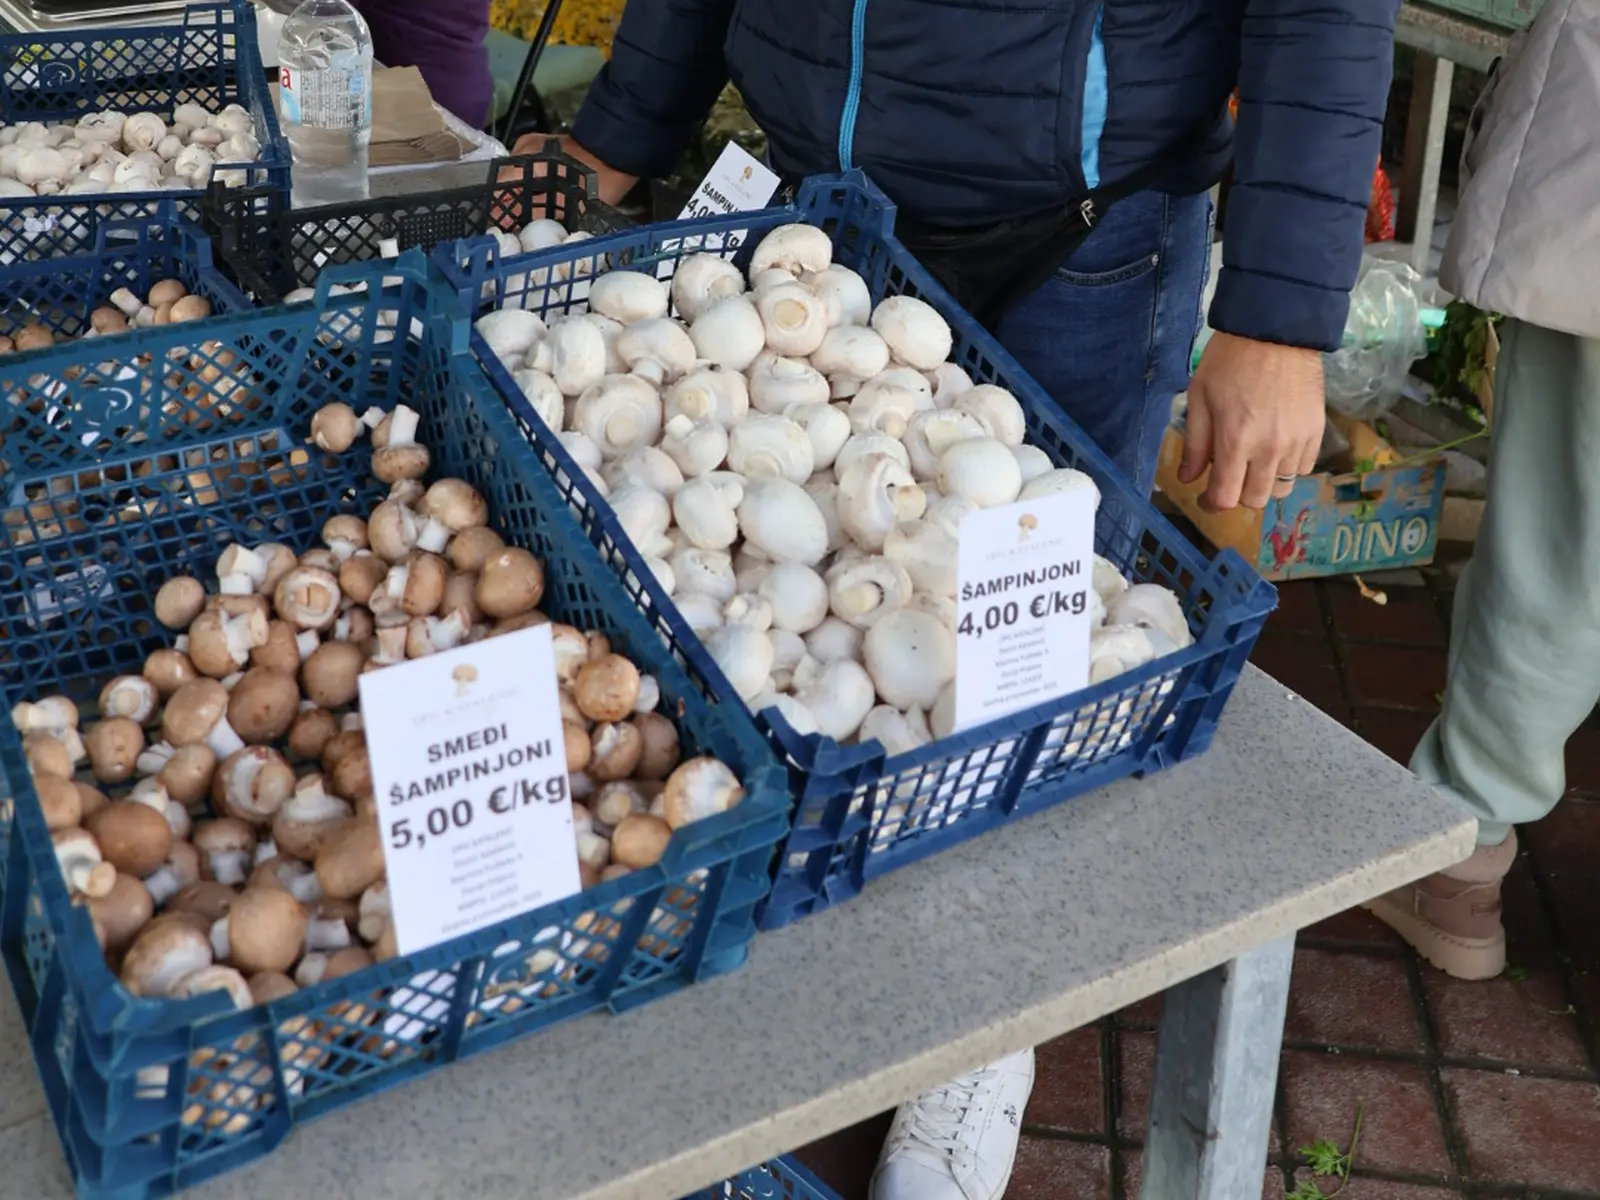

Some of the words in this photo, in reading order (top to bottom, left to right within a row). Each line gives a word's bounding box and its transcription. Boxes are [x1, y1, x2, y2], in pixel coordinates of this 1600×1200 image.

[1331, 514, 1430, 565] DINO
[961, 559, 1082, 602] ŠAMPINJONI
[957, 601, 1020, 639] 4,00
[1029, 589, 1088, 619] €/kg
[388, 738, 553, 806] ŠAMPINJONI
[390, 797, 474, 850] 5,00
[486, 773, 568, 815] €/kg
